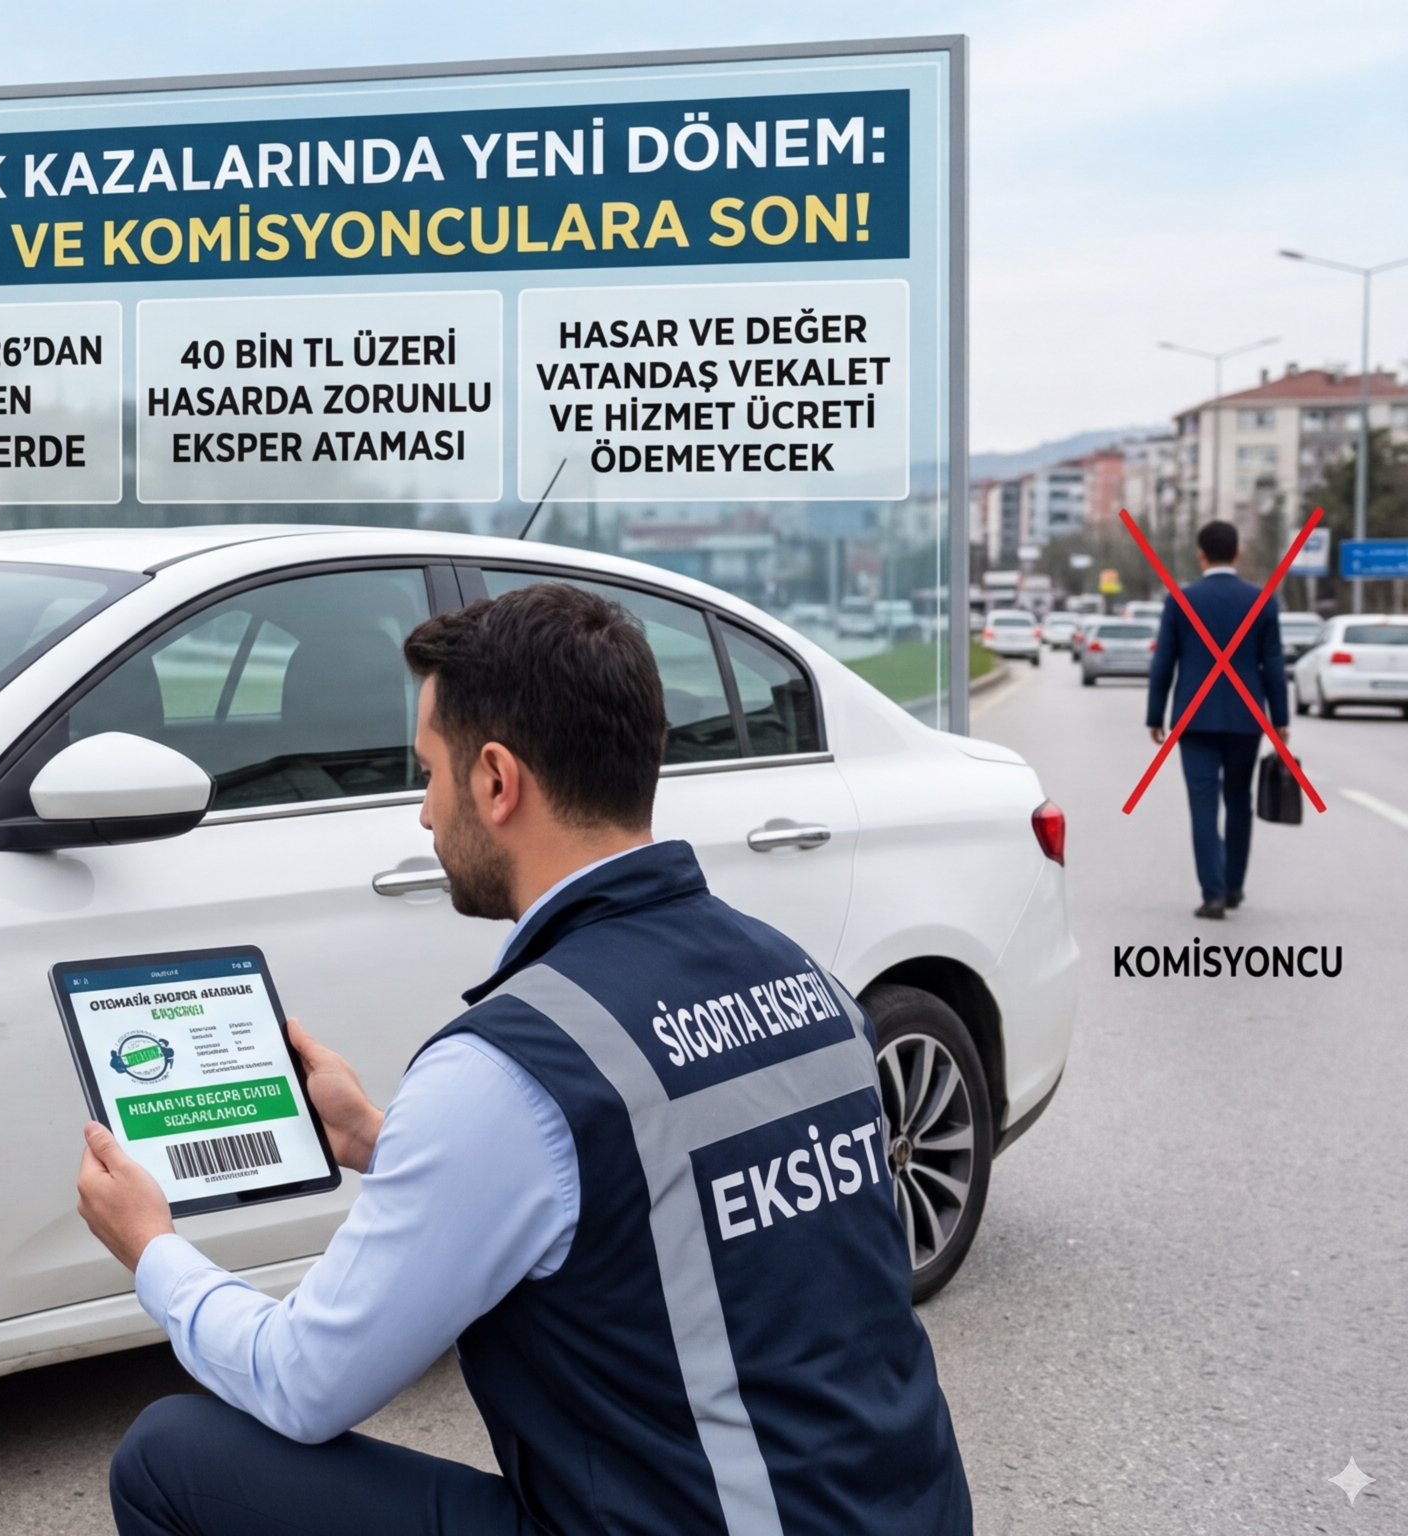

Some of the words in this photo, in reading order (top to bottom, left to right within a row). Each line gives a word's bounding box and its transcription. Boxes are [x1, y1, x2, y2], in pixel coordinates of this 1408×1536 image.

[23, 135, 445, 198] KAZALARINDA
[461, 117, 604, 179] YENİ
[628, 111, 885, 173] DÖNEM:
[10, 221, 84, 268] VE
[103, 199, 690, 265] KOMİSYONCULARA
[708, 192, 870, 247] SON!
[180, 339, 225, 370] 40
[236, 331, 293, 369] BİN
[303, 337, 344, 368] TL
[353, 327, 456, 367] ÜZERİ
[560, 319, 678, 349] HASAR
[688, 317, 735, 347] VE
[746, 307, 867, 345] DEĞER
[536, 360, 718, 393] VATANDAŞ
[728, 356, 891, 388] VEKALET
[148, 385, 314, 417] HASARDA
[323, 381, 491, 415] ZORUNLU
[549, 403, 593, 432] VE
[605, 396, 736, 432] HİZMET
[747, 392, 875, 430] ÜCRETİ
[173, 432, 303, 463] EKSPER
[311, 429, 465, 462] ATAMASI
[590, 438, 835, 474] ÖDEMEYECEK
[652, 993, 767, 1067] SİGORTA
